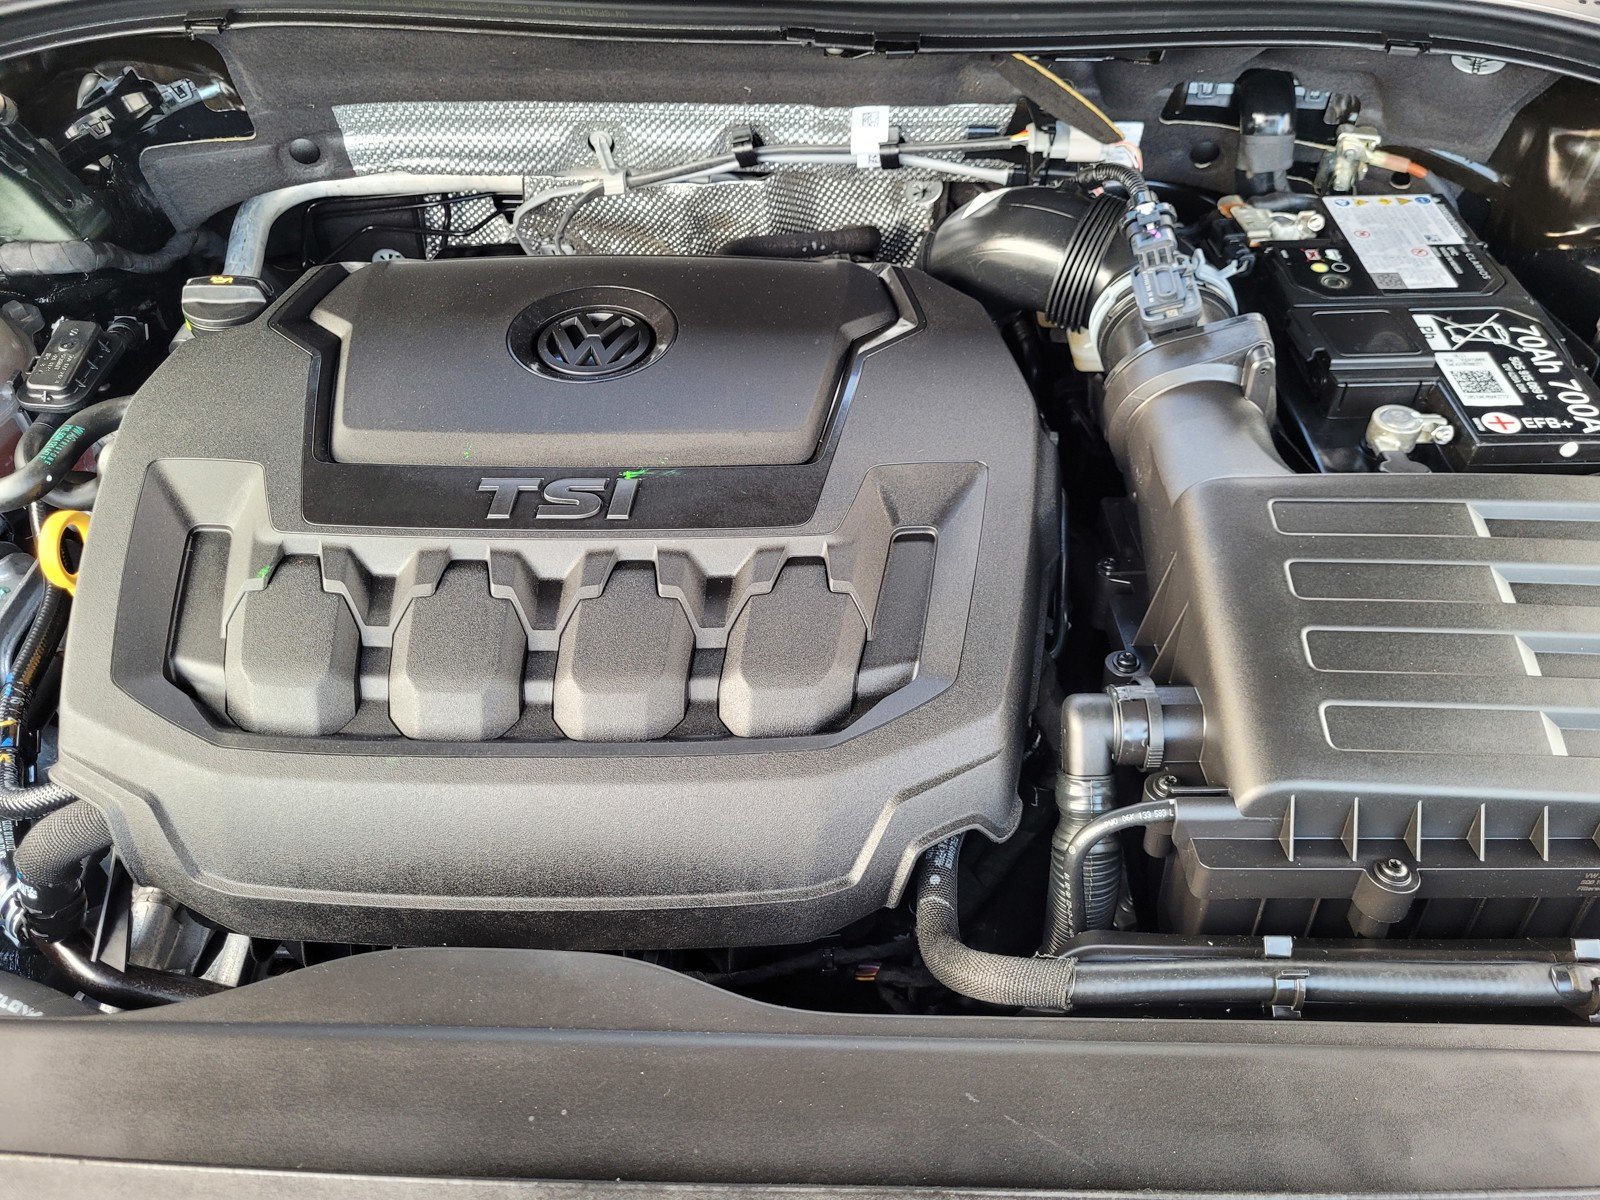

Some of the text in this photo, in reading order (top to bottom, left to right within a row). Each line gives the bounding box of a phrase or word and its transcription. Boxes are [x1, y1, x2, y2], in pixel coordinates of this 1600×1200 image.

[538, 305, 656, 374] VW
[1508, 325, 1600, 434] 70Ah 700A
[1521, 417, 1573, 428] EFB+
[476, 477, 642, 520] TSI
[1138, 810, 1152, 820] 133
[1153, 808, 1167, 818] 583
